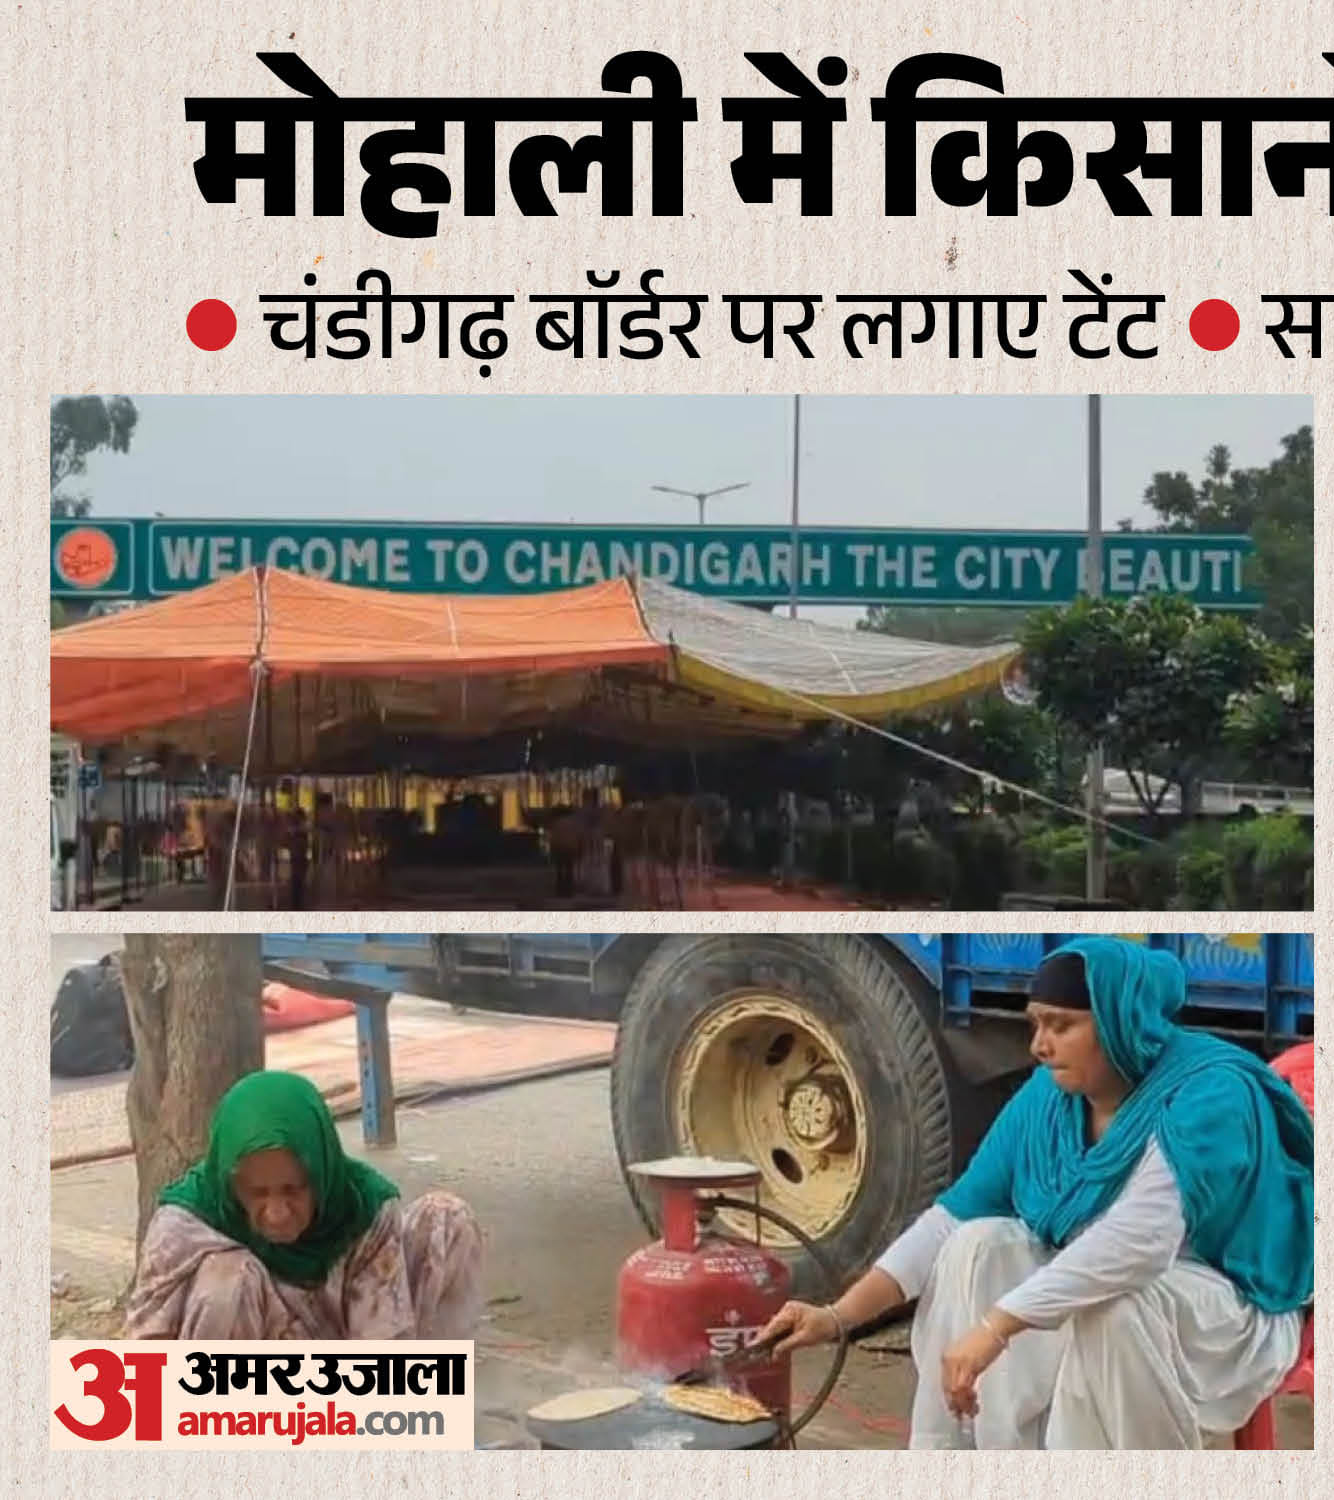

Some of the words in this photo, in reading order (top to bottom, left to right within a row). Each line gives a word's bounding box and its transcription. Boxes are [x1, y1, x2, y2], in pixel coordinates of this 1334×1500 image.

[425, 539, 490, 584] TO
[503, 540, 831, 587] CHANDIGARH
[846, 545, 938, 588] THE
[954, 547, 1061, 591] CITY
